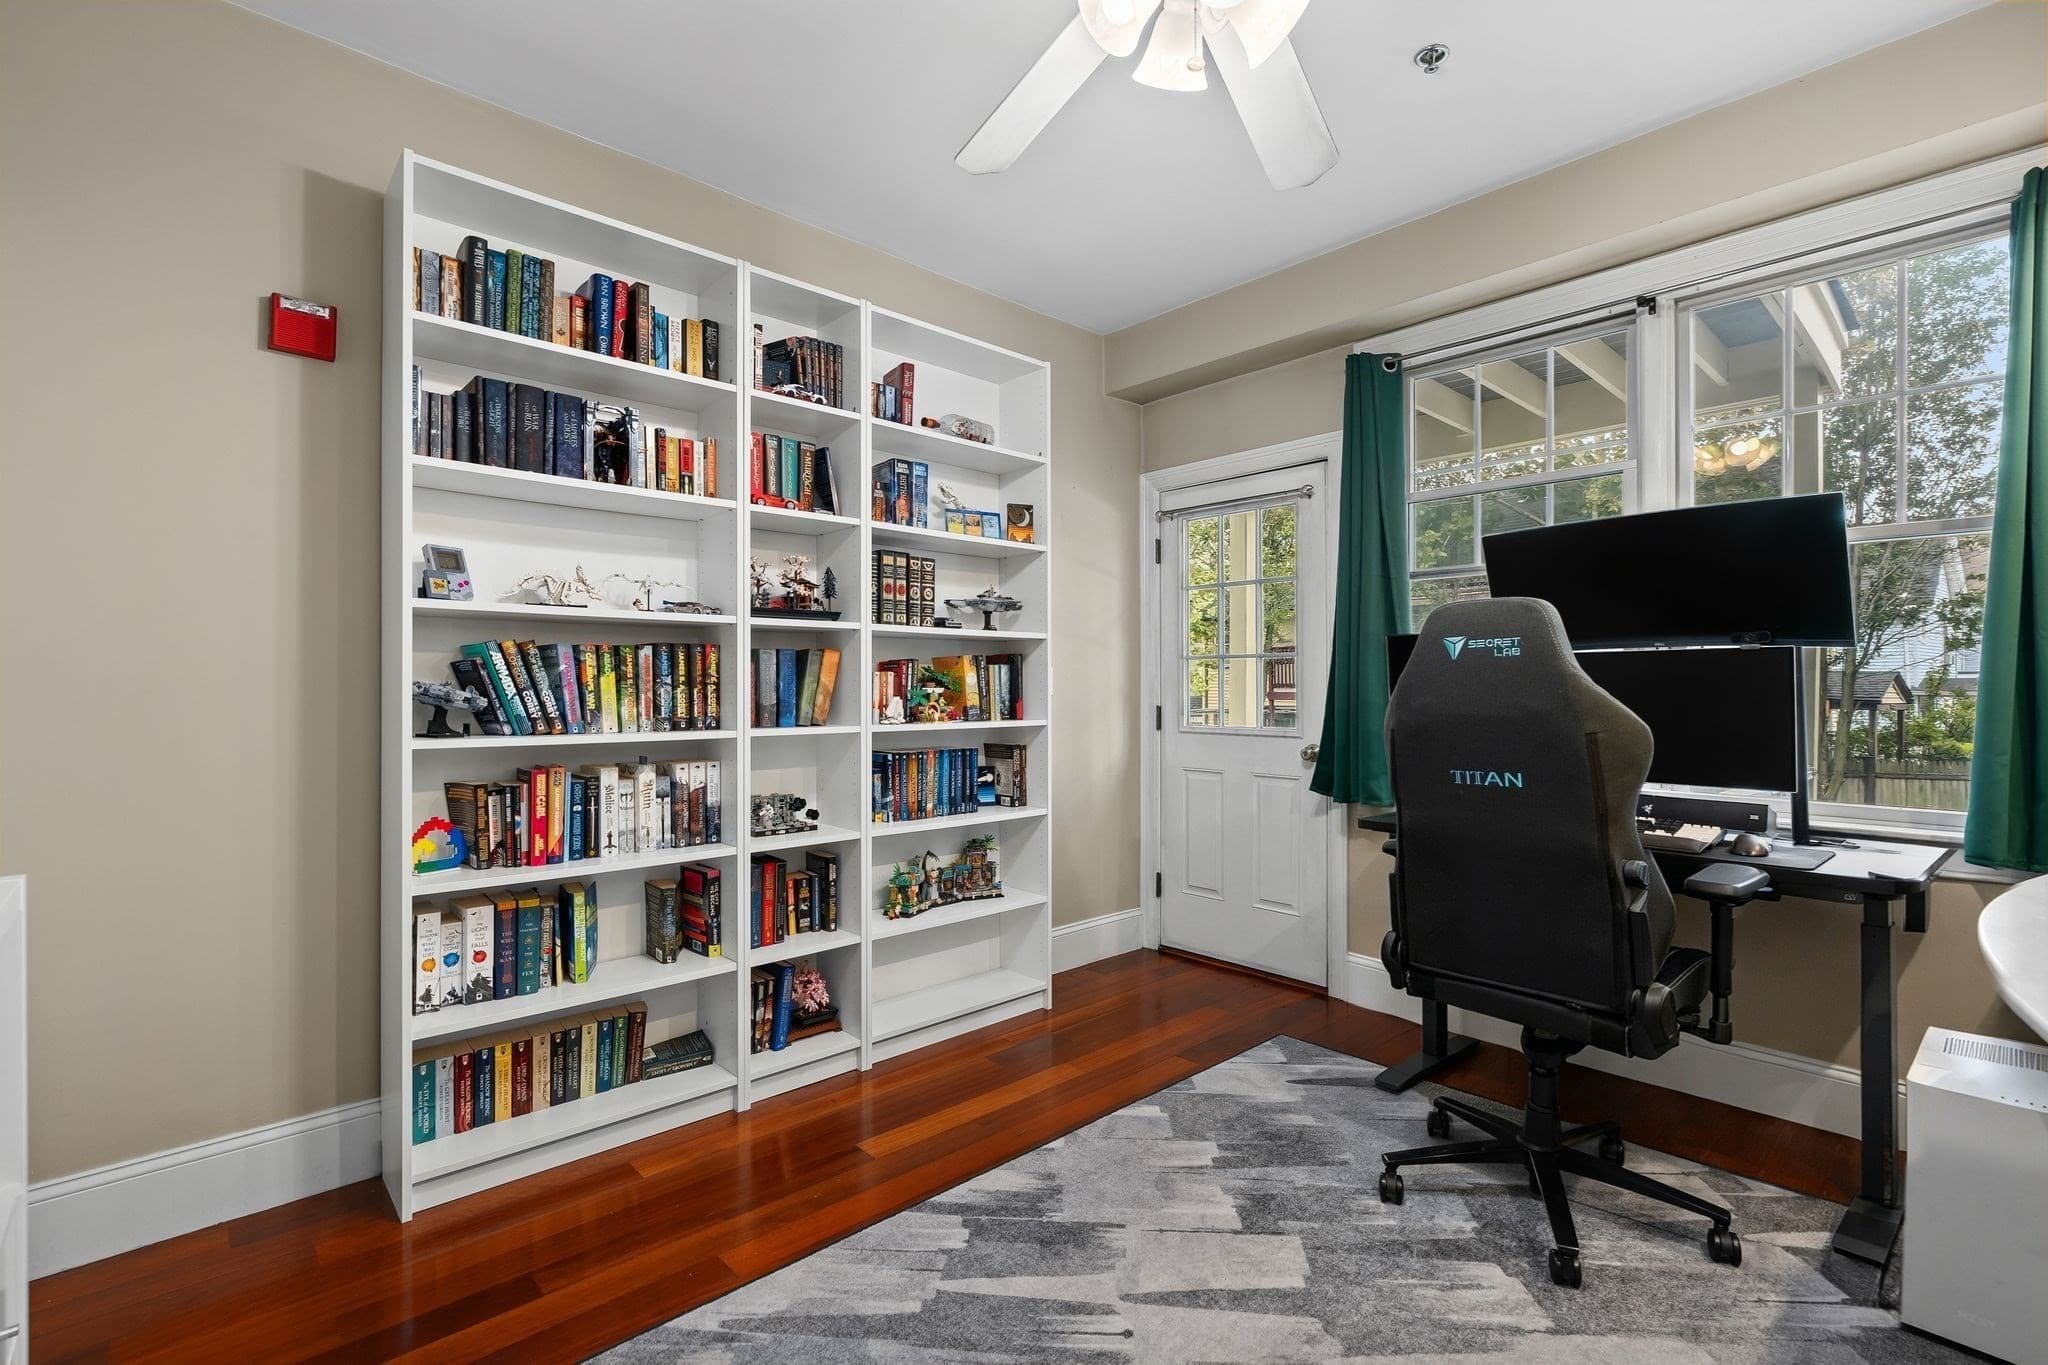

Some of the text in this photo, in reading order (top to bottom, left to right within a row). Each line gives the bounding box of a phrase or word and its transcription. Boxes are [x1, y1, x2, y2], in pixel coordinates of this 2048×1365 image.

[640, 329, 648, 362] RISING
[802, 456, 812, 494] MURTAGH
[1468, 637, 1521, 648] SECRET
[1495, 648, 1520, 656] LAB
[490, 651, 515, 699] ARMADA
[514, 668, 526, 688] GODS
[522, 691, 537, 718] COREY
[542, 691, 555, 717] COREY
[1450, 770, 1523, 788] TITAN
